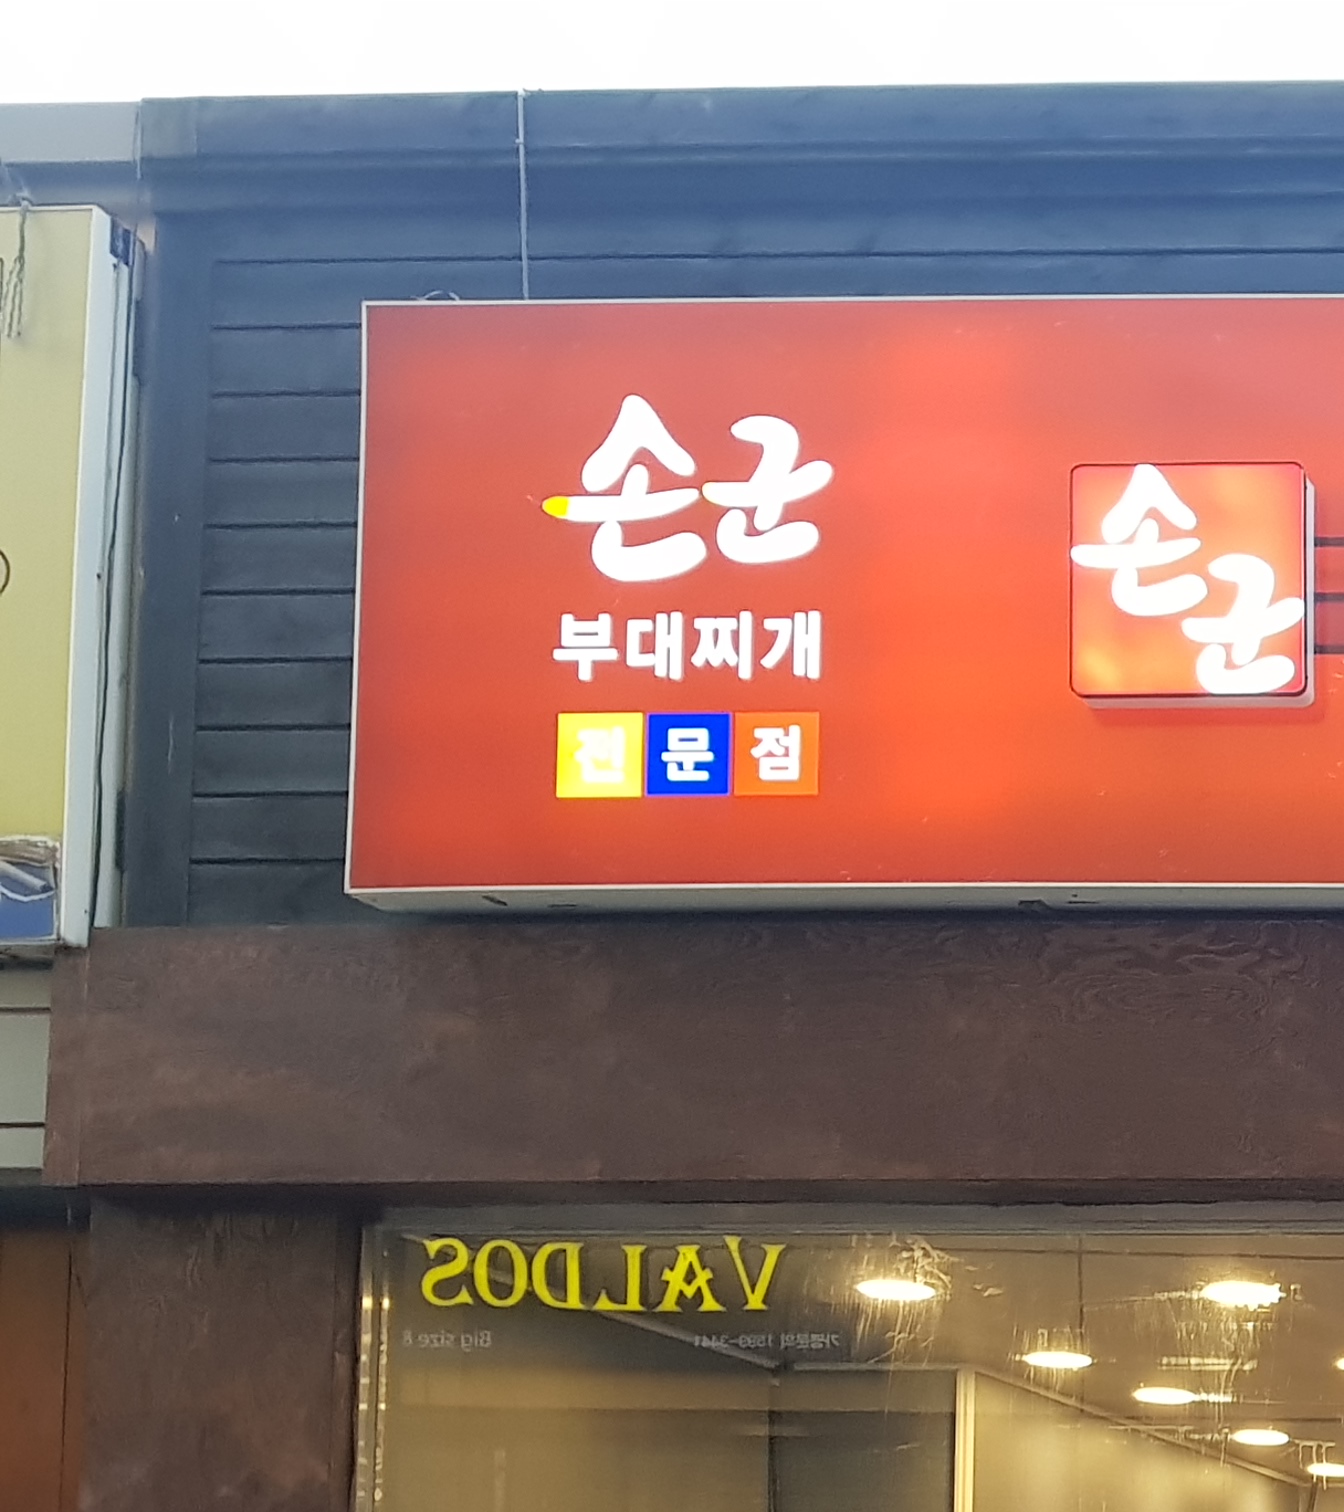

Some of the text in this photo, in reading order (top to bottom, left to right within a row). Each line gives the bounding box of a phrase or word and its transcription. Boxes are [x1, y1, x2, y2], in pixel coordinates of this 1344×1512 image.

[541, 395, 834, 582] 손군
[1070, 463, 1306, 696] 손군
[552, 609, 823, 684] 부대찌개
[572, 722, 803, 786] 전문점
